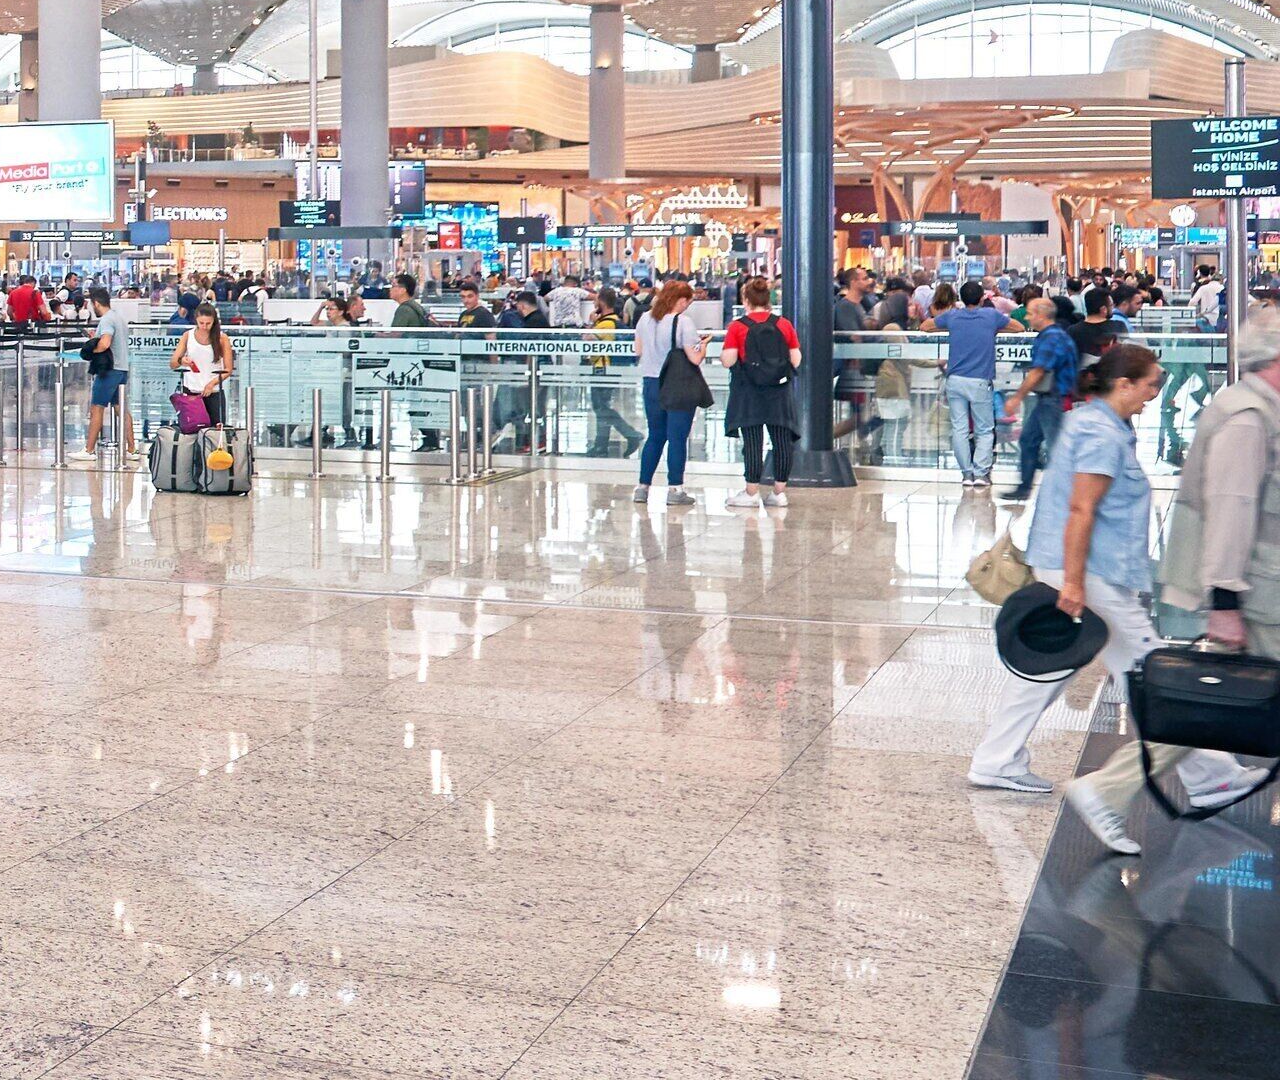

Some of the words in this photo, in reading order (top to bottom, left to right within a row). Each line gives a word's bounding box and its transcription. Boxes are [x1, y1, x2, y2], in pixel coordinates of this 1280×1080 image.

[1192, 119, 1278, 132] WELCOME
[1210, 132, 1260, 144] HOME
[1211, 151, 1259, 162] EVİNİZE
[0, 164, 48, 181] Media
[1193, 163, 1219, 173] HOŞ
[1239, 185, 1277, 197] Airport
[153, 207, 228, 221] ELECTRONICS
[22, 232, 32, 241] 33
[104, 232, 114, 240] 34
[485, 342, 580, 353] INTERNATIONAL
[582, 342, 636, 354] DEPARTU
